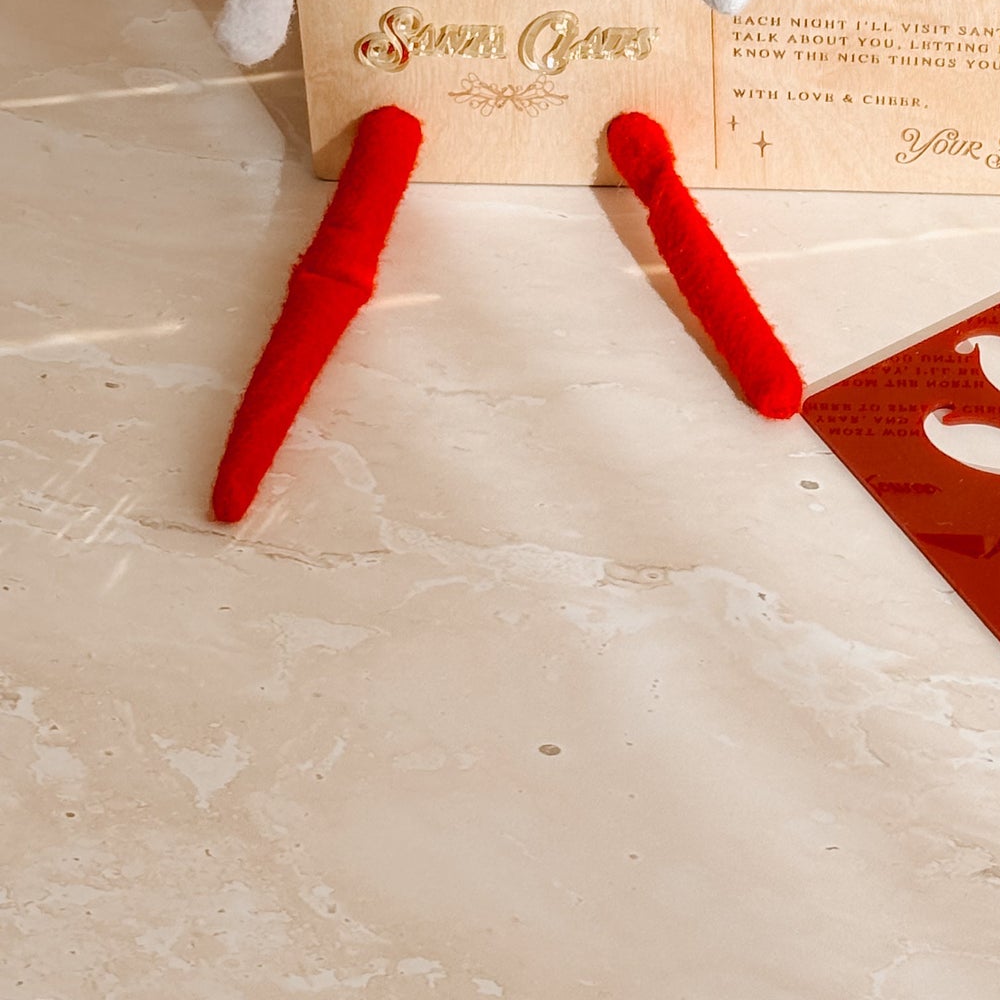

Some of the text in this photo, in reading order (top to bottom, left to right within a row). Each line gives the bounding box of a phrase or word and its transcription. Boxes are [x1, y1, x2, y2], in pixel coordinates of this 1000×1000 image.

[732, 15, 781, 27] EACH
[790, 17, 845, 31] NIGHT
[856, 20, 893, 32] I'LL
[901, 22, 950, 35] VISIT
[731, 31, 778, 43] TALK
[786, 34, 849, 47] ABOUT
[909, 40, 989, 54] LETTING
[732, 47, 787, 60] KNOW
[793, 50, 829, 62] THE
[837, 52, 880, 64] NICE
[888, 55, 957, 69] THINGS
[732, 88, 778, 100] WITH
[787, 91, 834, 103] LOVE
[842, 93, 853, 104] &
[895, 127, 983, 164] YOUR
